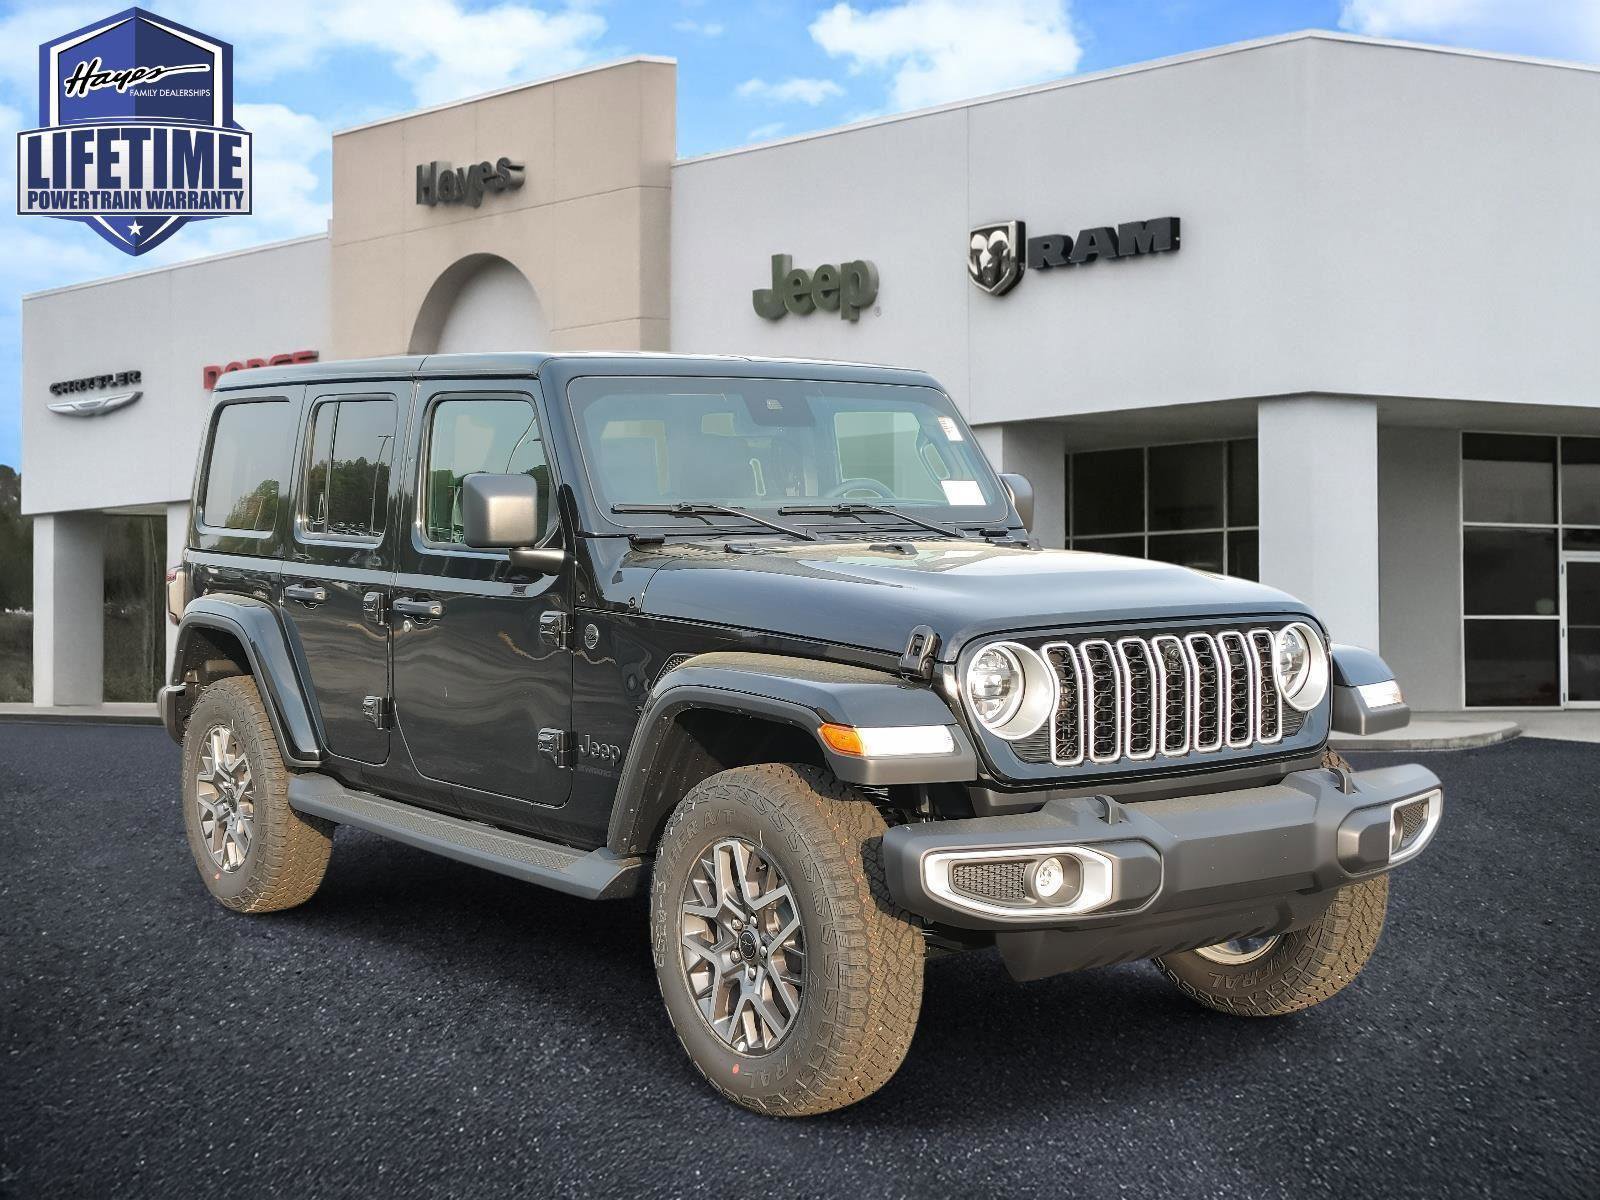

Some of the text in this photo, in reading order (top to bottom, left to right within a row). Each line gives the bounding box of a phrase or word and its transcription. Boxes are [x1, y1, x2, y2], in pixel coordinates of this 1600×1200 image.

[416, 157, 525, 209] Hayes
[1027, 217, 1180, 270] RAM
[753, 254, 879, 321] Jeep
[578, 734, 621, 767] Jeep
